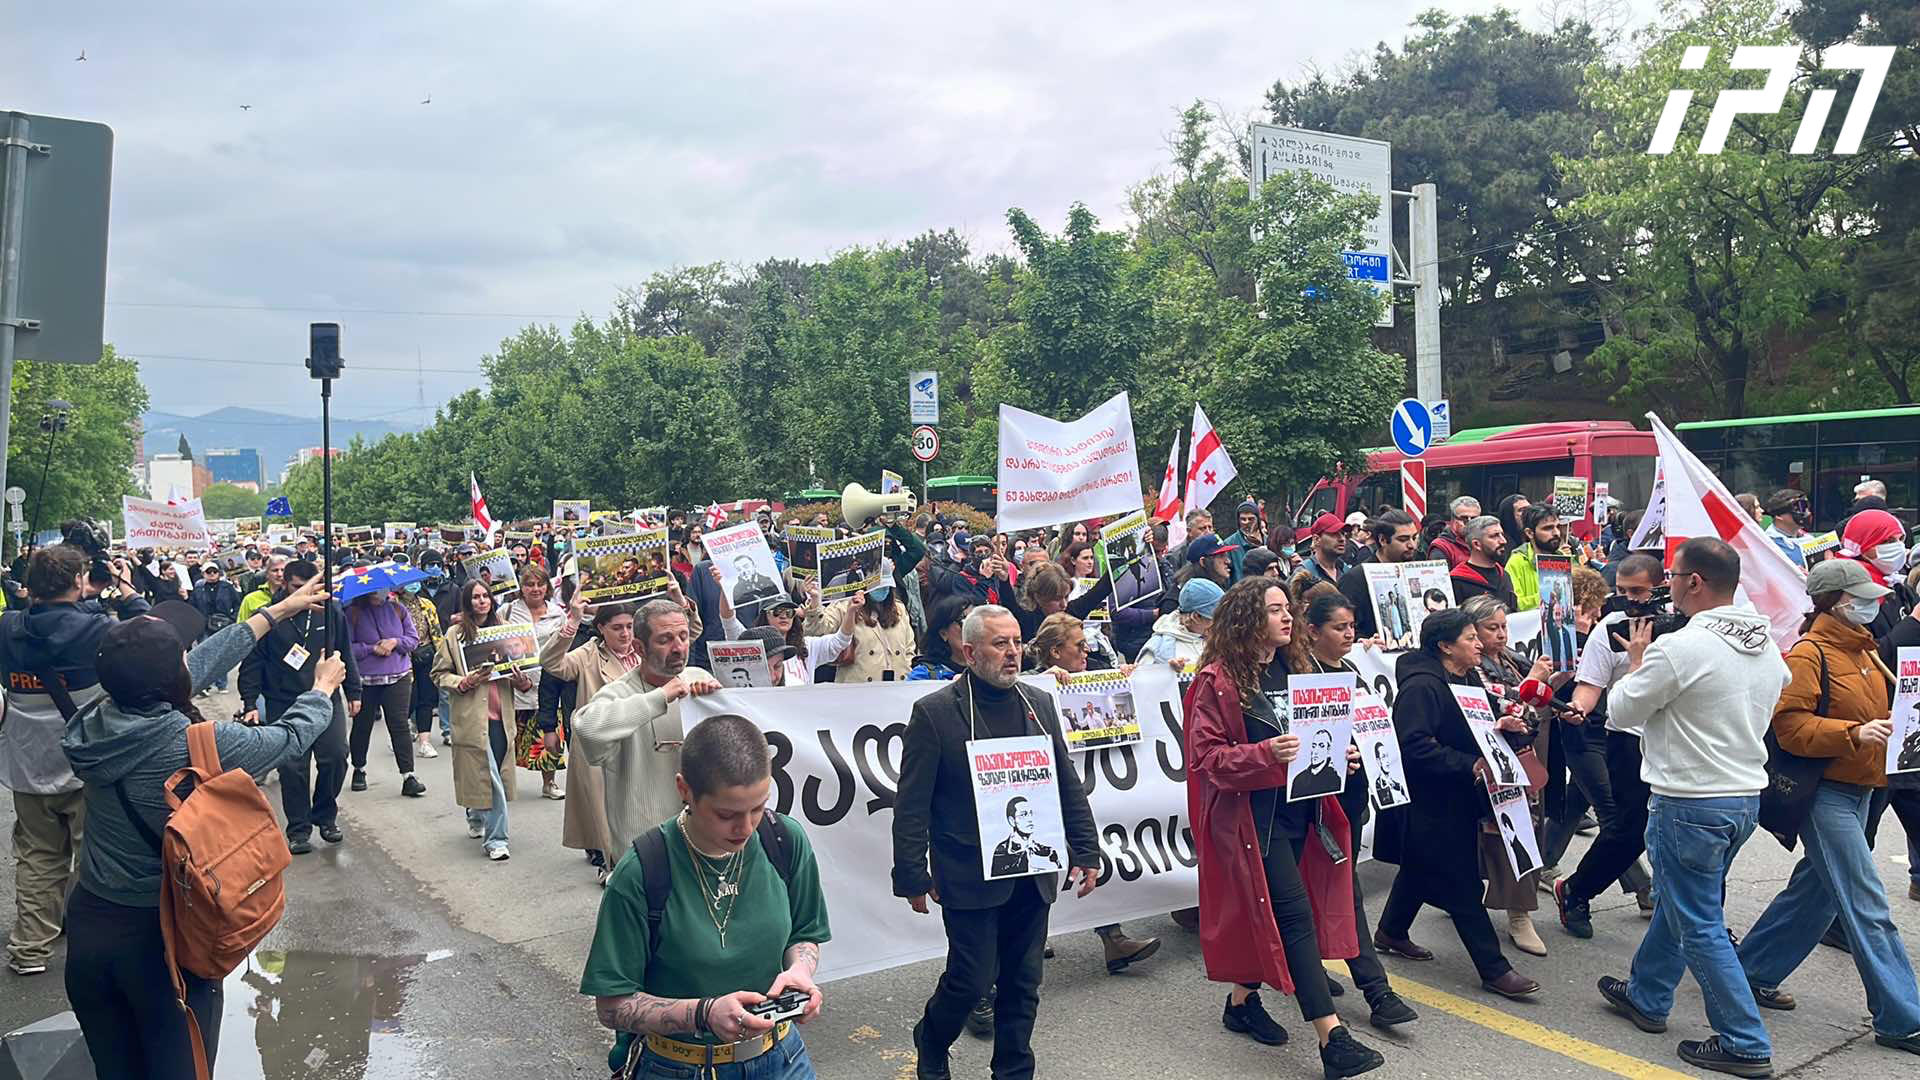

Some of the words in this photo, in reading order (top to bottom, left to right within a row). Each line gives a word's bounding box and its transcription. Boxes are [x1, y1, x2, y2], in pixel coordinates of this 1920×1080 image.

[1005, 457, 1020, 469] და
[1293, 688, 1352, 706] თავისუფლება
[975, 750, 1051, 772] თავისუფლება
